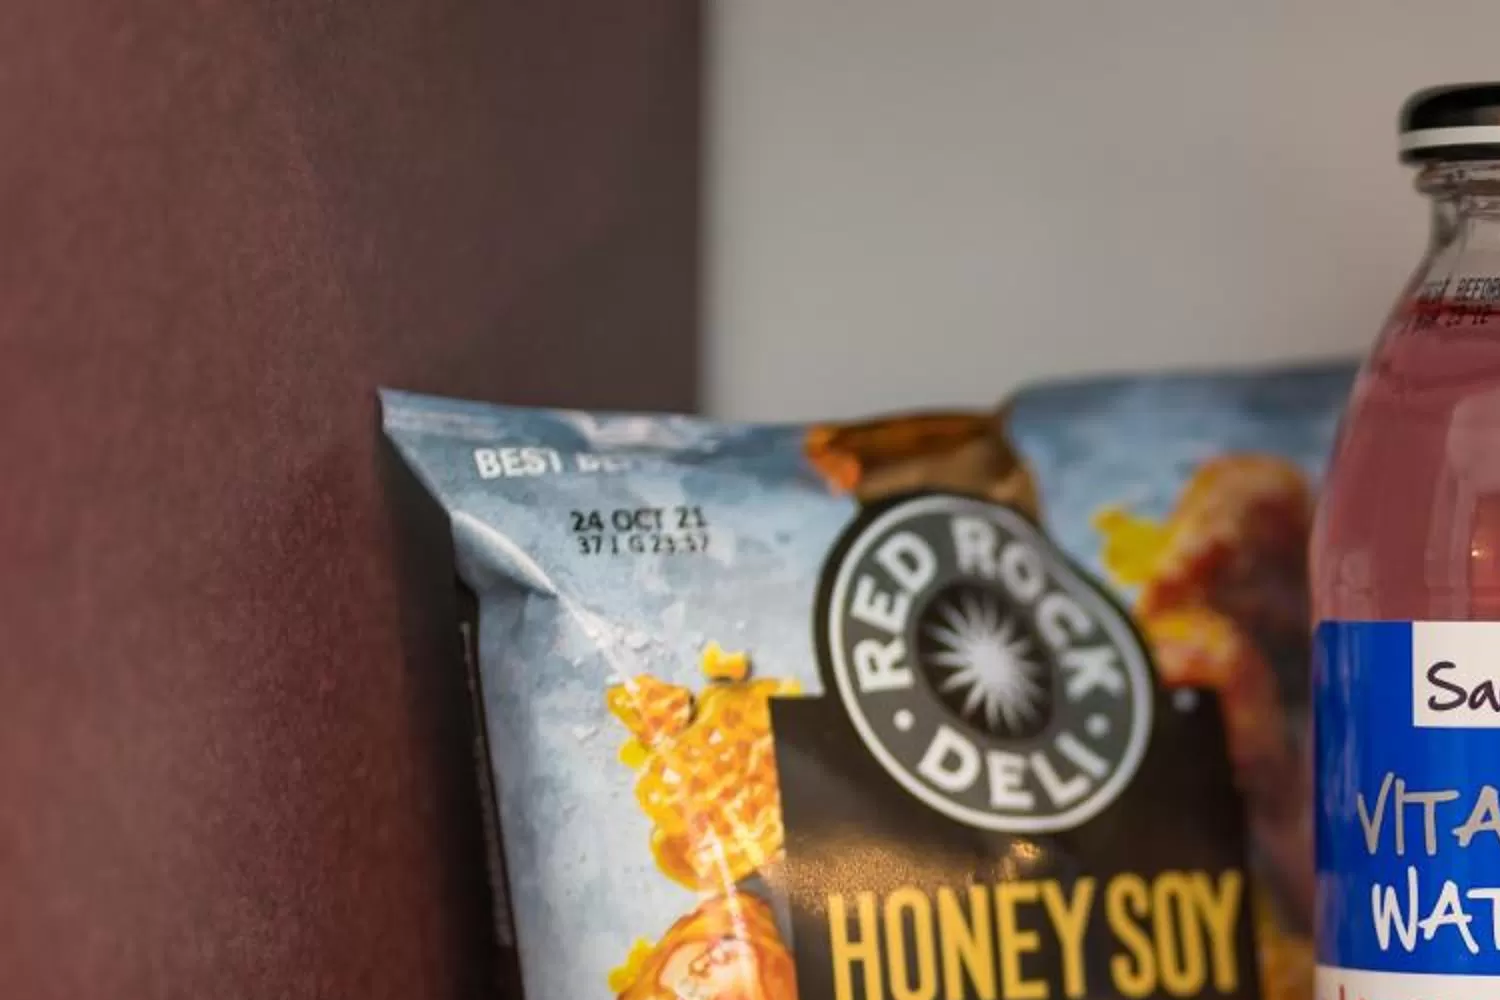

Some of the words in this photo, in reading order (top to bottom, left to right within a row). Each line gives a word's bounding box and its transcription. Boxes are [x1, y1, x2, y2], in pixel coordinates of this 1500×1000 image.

[570, 509, 605, 532] 24
[611, 507, 664, 531] OCT
[674, 504, 708, 530] 21
[851, 531, 937, 693] RED
[951, 517, 1125, 701] ROCK
[918, 726, 1110, 810] DELI
[1105, 869, 1243, 1000] SOY
